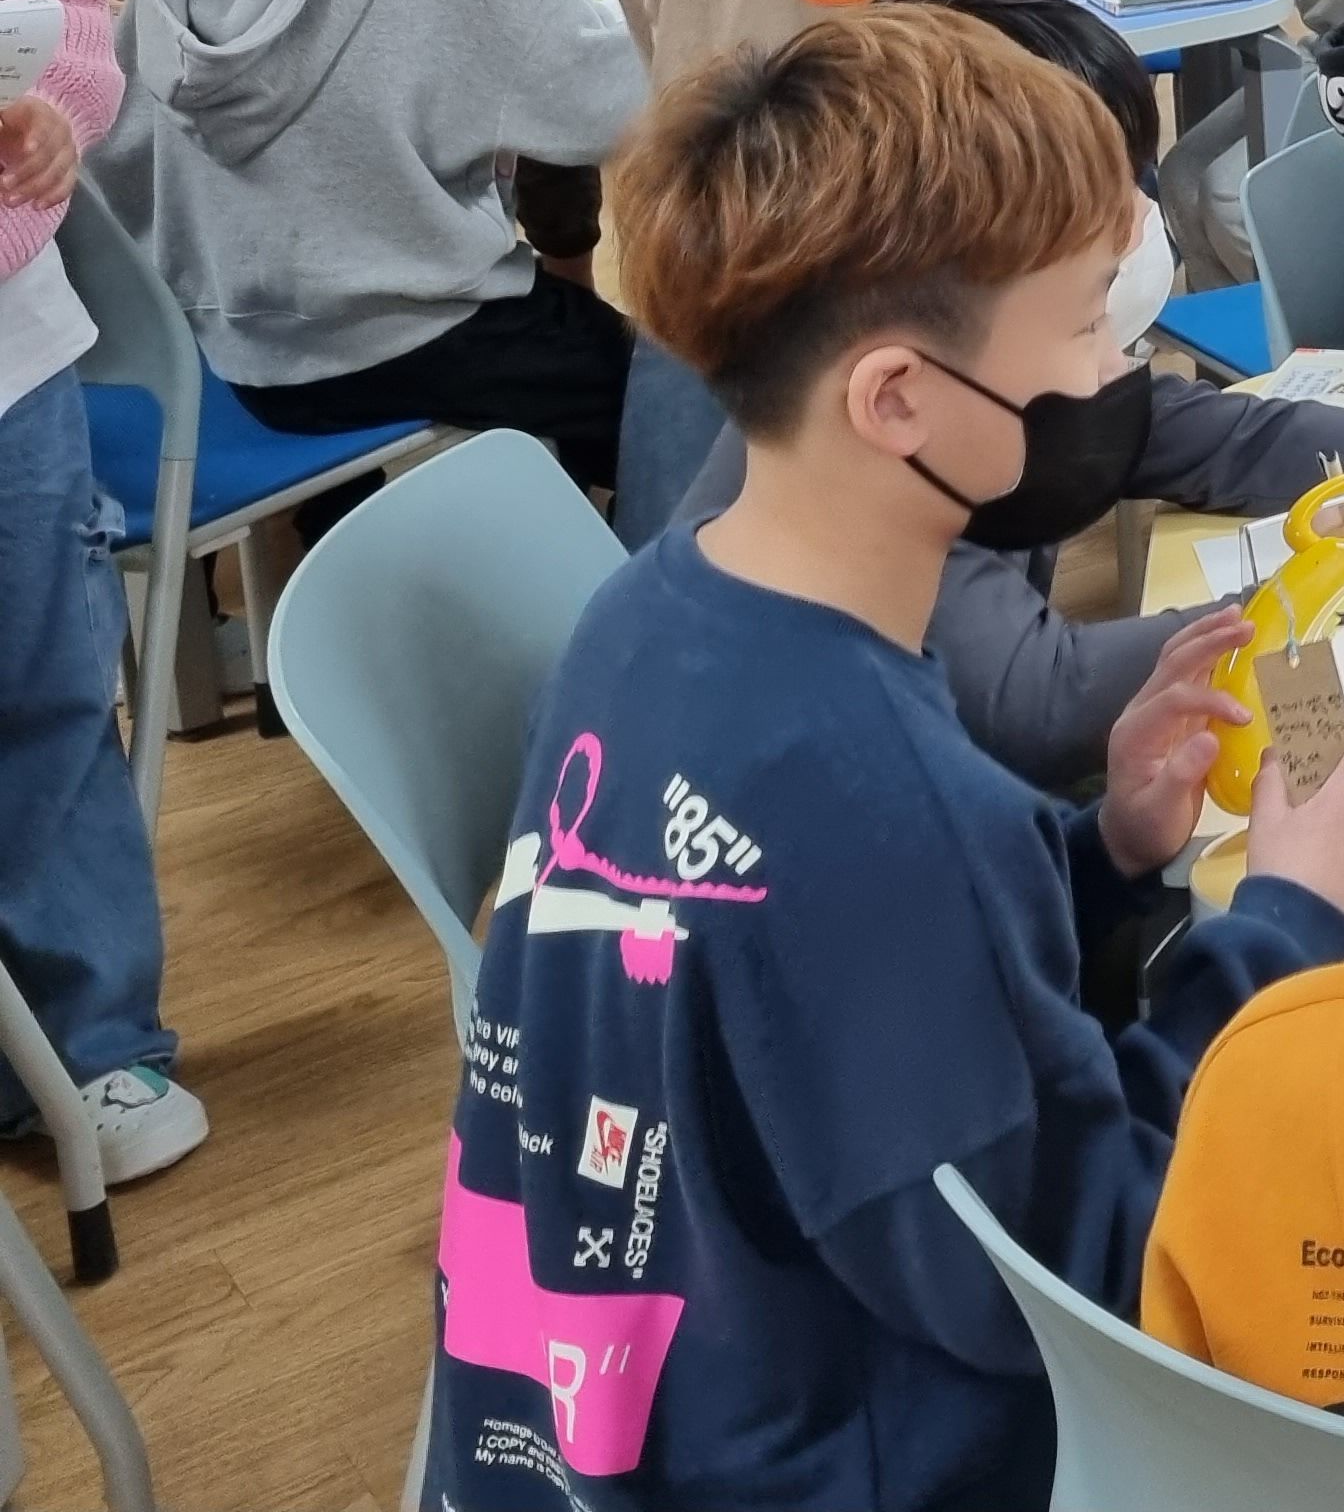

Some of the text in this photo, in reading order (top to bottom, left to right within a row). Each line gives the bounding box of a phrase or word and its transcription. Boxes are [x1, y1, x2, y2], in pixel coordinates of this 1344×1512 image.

[483, 1417, 532, 1439] Homage
[486, 1433, 526, 1452] COPY
[474, 1446, 496, 1467] My
[499, 1452, 534, 1469] name
